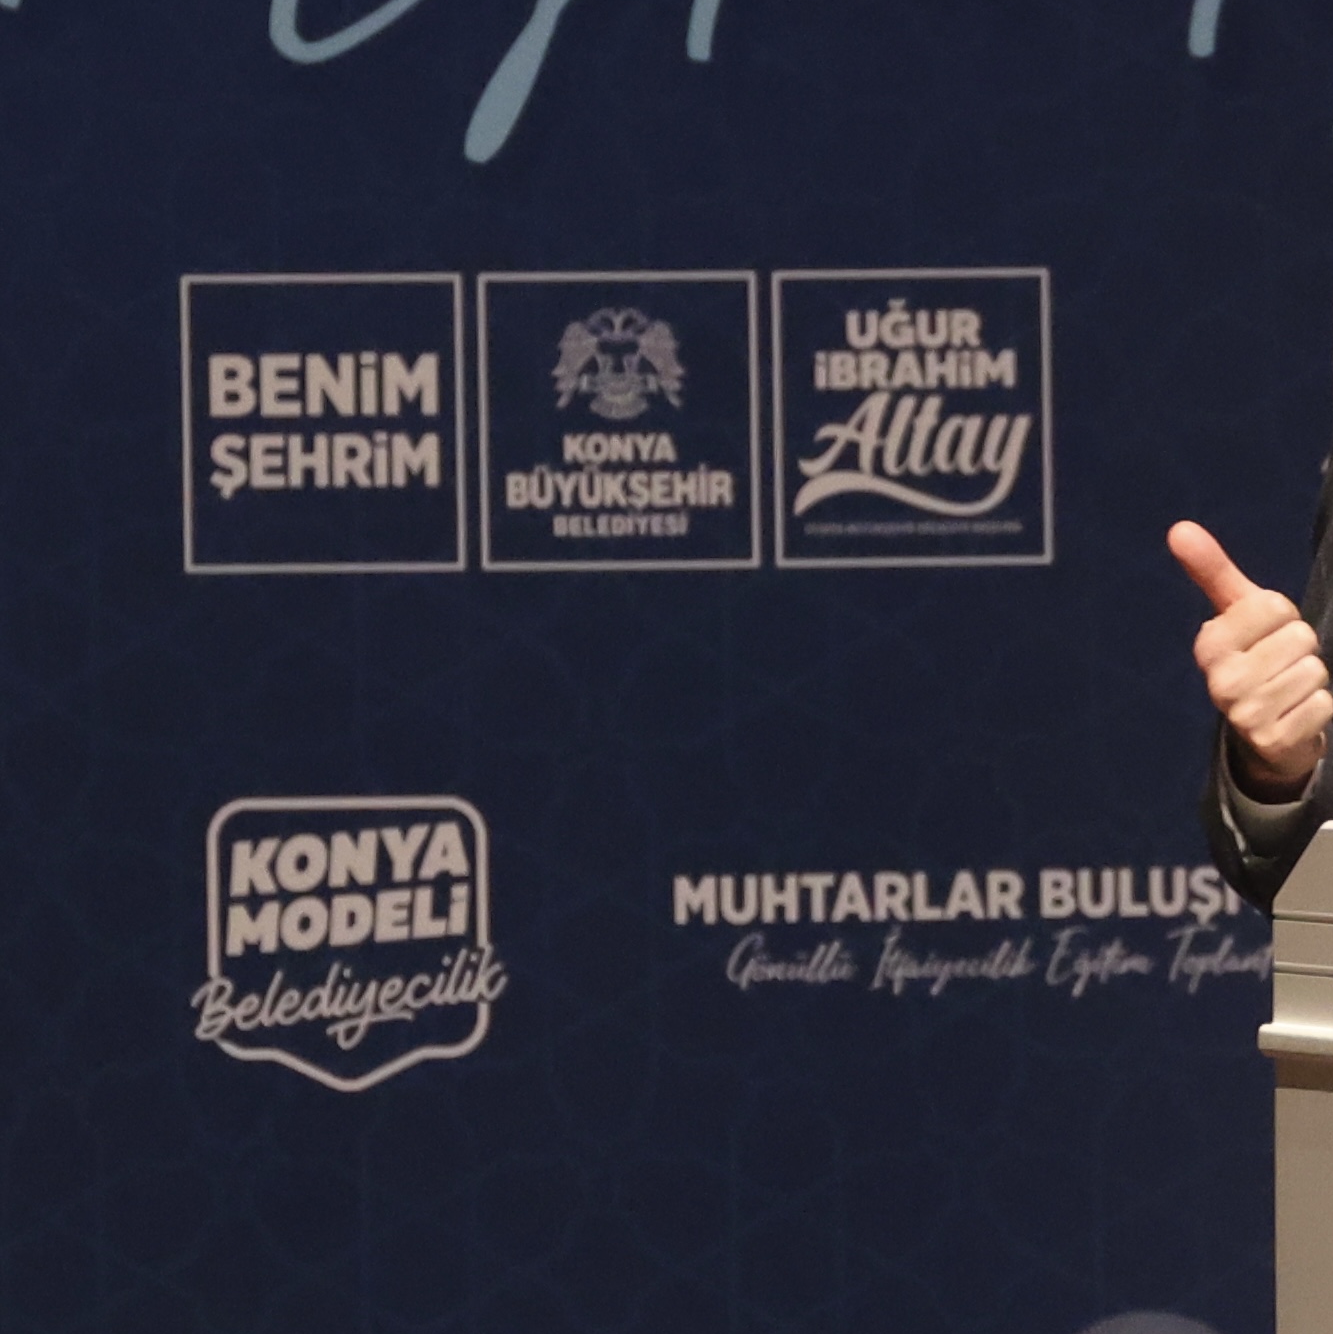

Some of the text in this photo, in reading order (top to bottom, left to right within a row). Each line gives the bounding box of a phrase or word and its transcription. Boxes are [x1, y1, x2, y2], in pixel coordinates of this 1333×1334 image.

[846, 299, 981, 350] UĞUR
[564, 433, 676, 465] KONYA
[794, 389, 1031, 516] Altay
[230, 821, 470, 897] KONYA
[674, 870, 1024, 925] MUHTARLAR
[191, 942, 508, 1050] Belediyecilik
